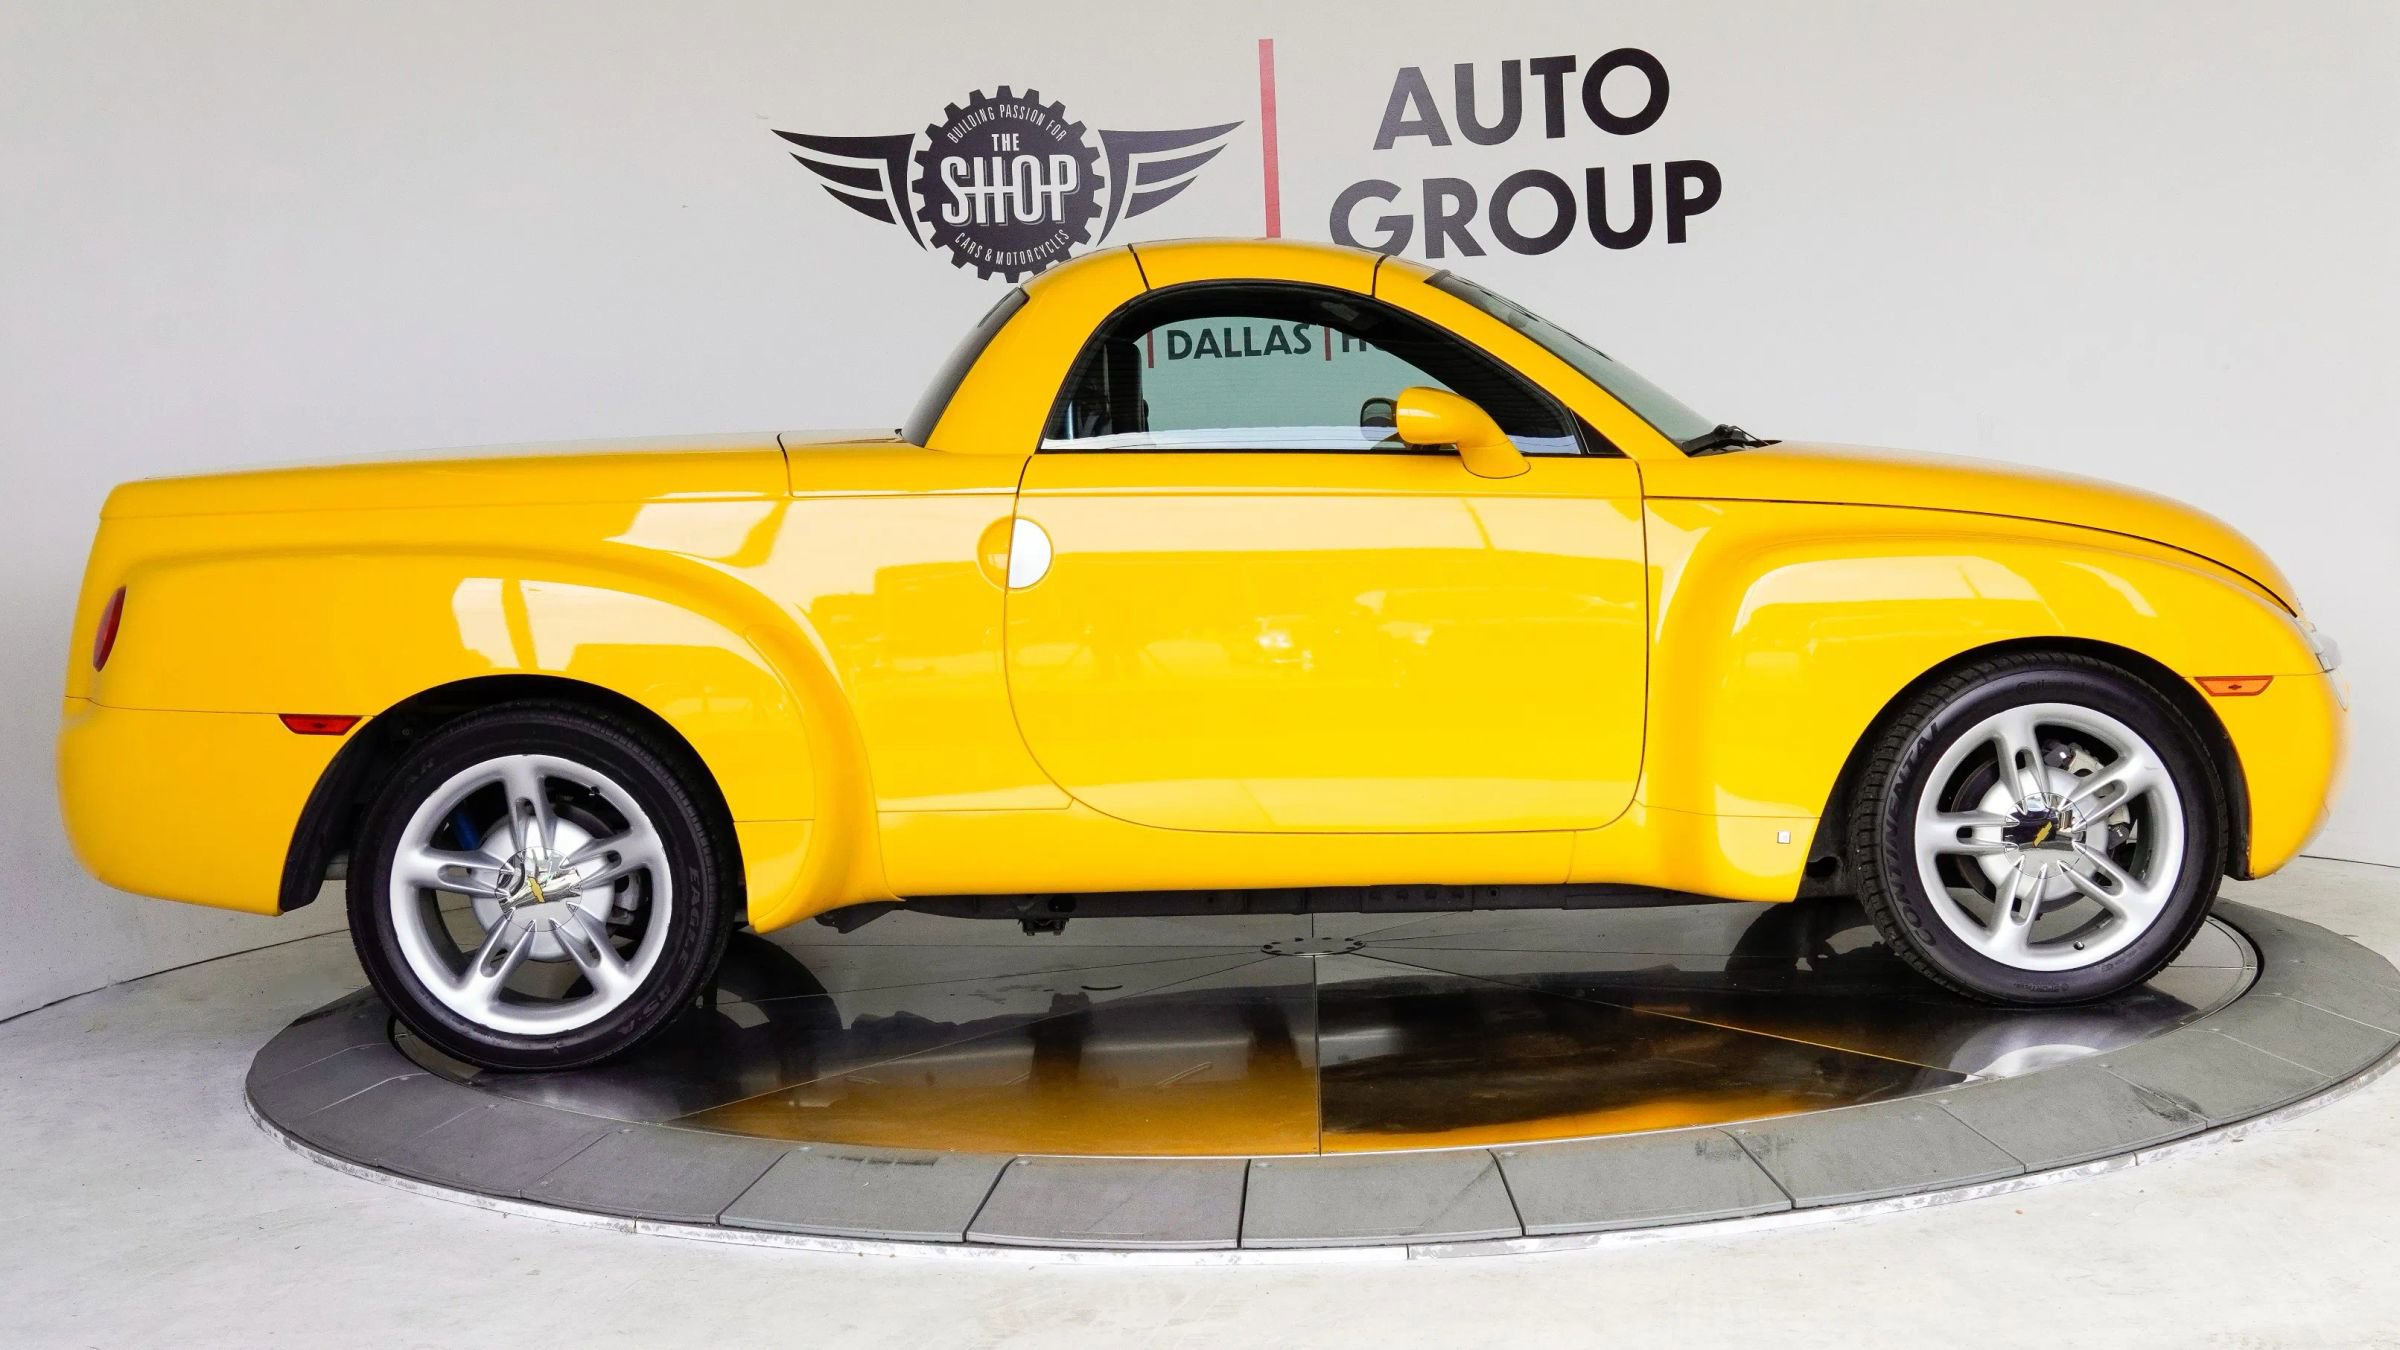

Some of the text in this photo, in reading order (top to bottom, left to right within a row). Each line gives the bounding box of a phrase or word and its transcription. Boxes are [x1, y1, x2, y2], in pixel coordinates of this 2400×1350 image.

[1373, 47, 1670, 150] AUTO
[947, 104, 1067, 143] BUILDING PASSION FOR
[991, 133, 1020, 152] THE
[940, 154, 1080, 226] SHOP
[1329, 159, 1723, 259] GROUP
[955, 229, 1070, 266] CARS & MOTORCYCLES
[1167, 323, 1311, 360] DALLAS
